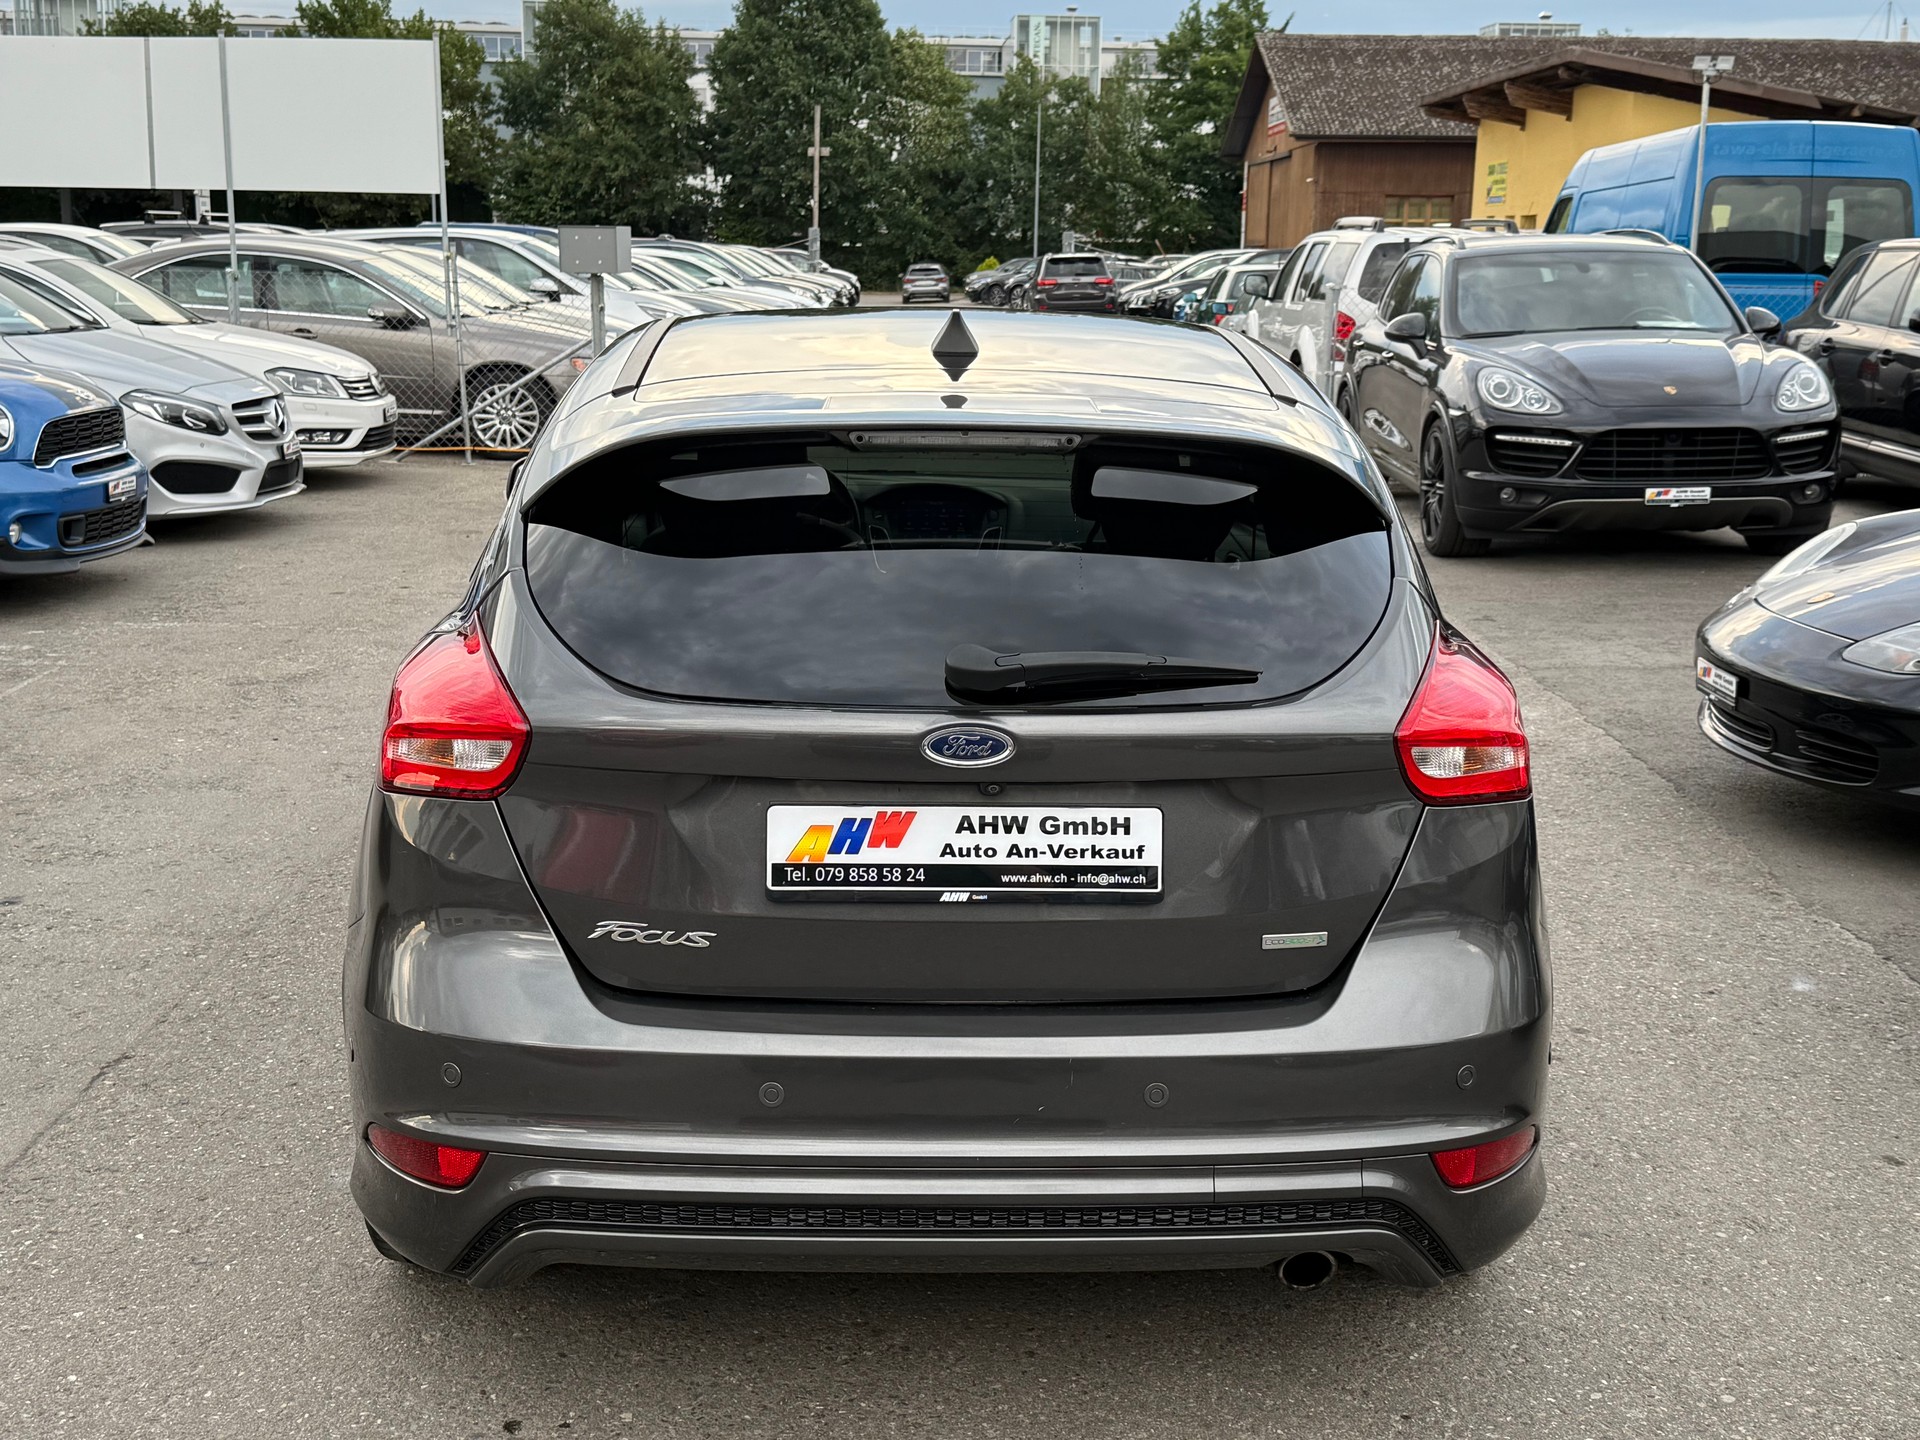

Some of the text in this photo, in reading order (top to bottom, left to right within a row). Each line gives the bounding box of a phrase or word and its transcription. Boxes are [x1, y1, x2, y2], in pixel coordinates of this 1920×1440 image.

[942, 734, 994, 757] Ford
[955, 815, 1132, 836] AHW GmbH
[785, 811, 918, 863] AHW
[939, 843, 1146, 860] Auto An-Verkauf
[784, 867, 926, 882] Tel. 079 858 58 24
[1001, 873, 1068, 884] www.ahw.ch
[1077, 873, 1147, 886] info@ahw.ch
[939, 891, 971, 902] AHW
